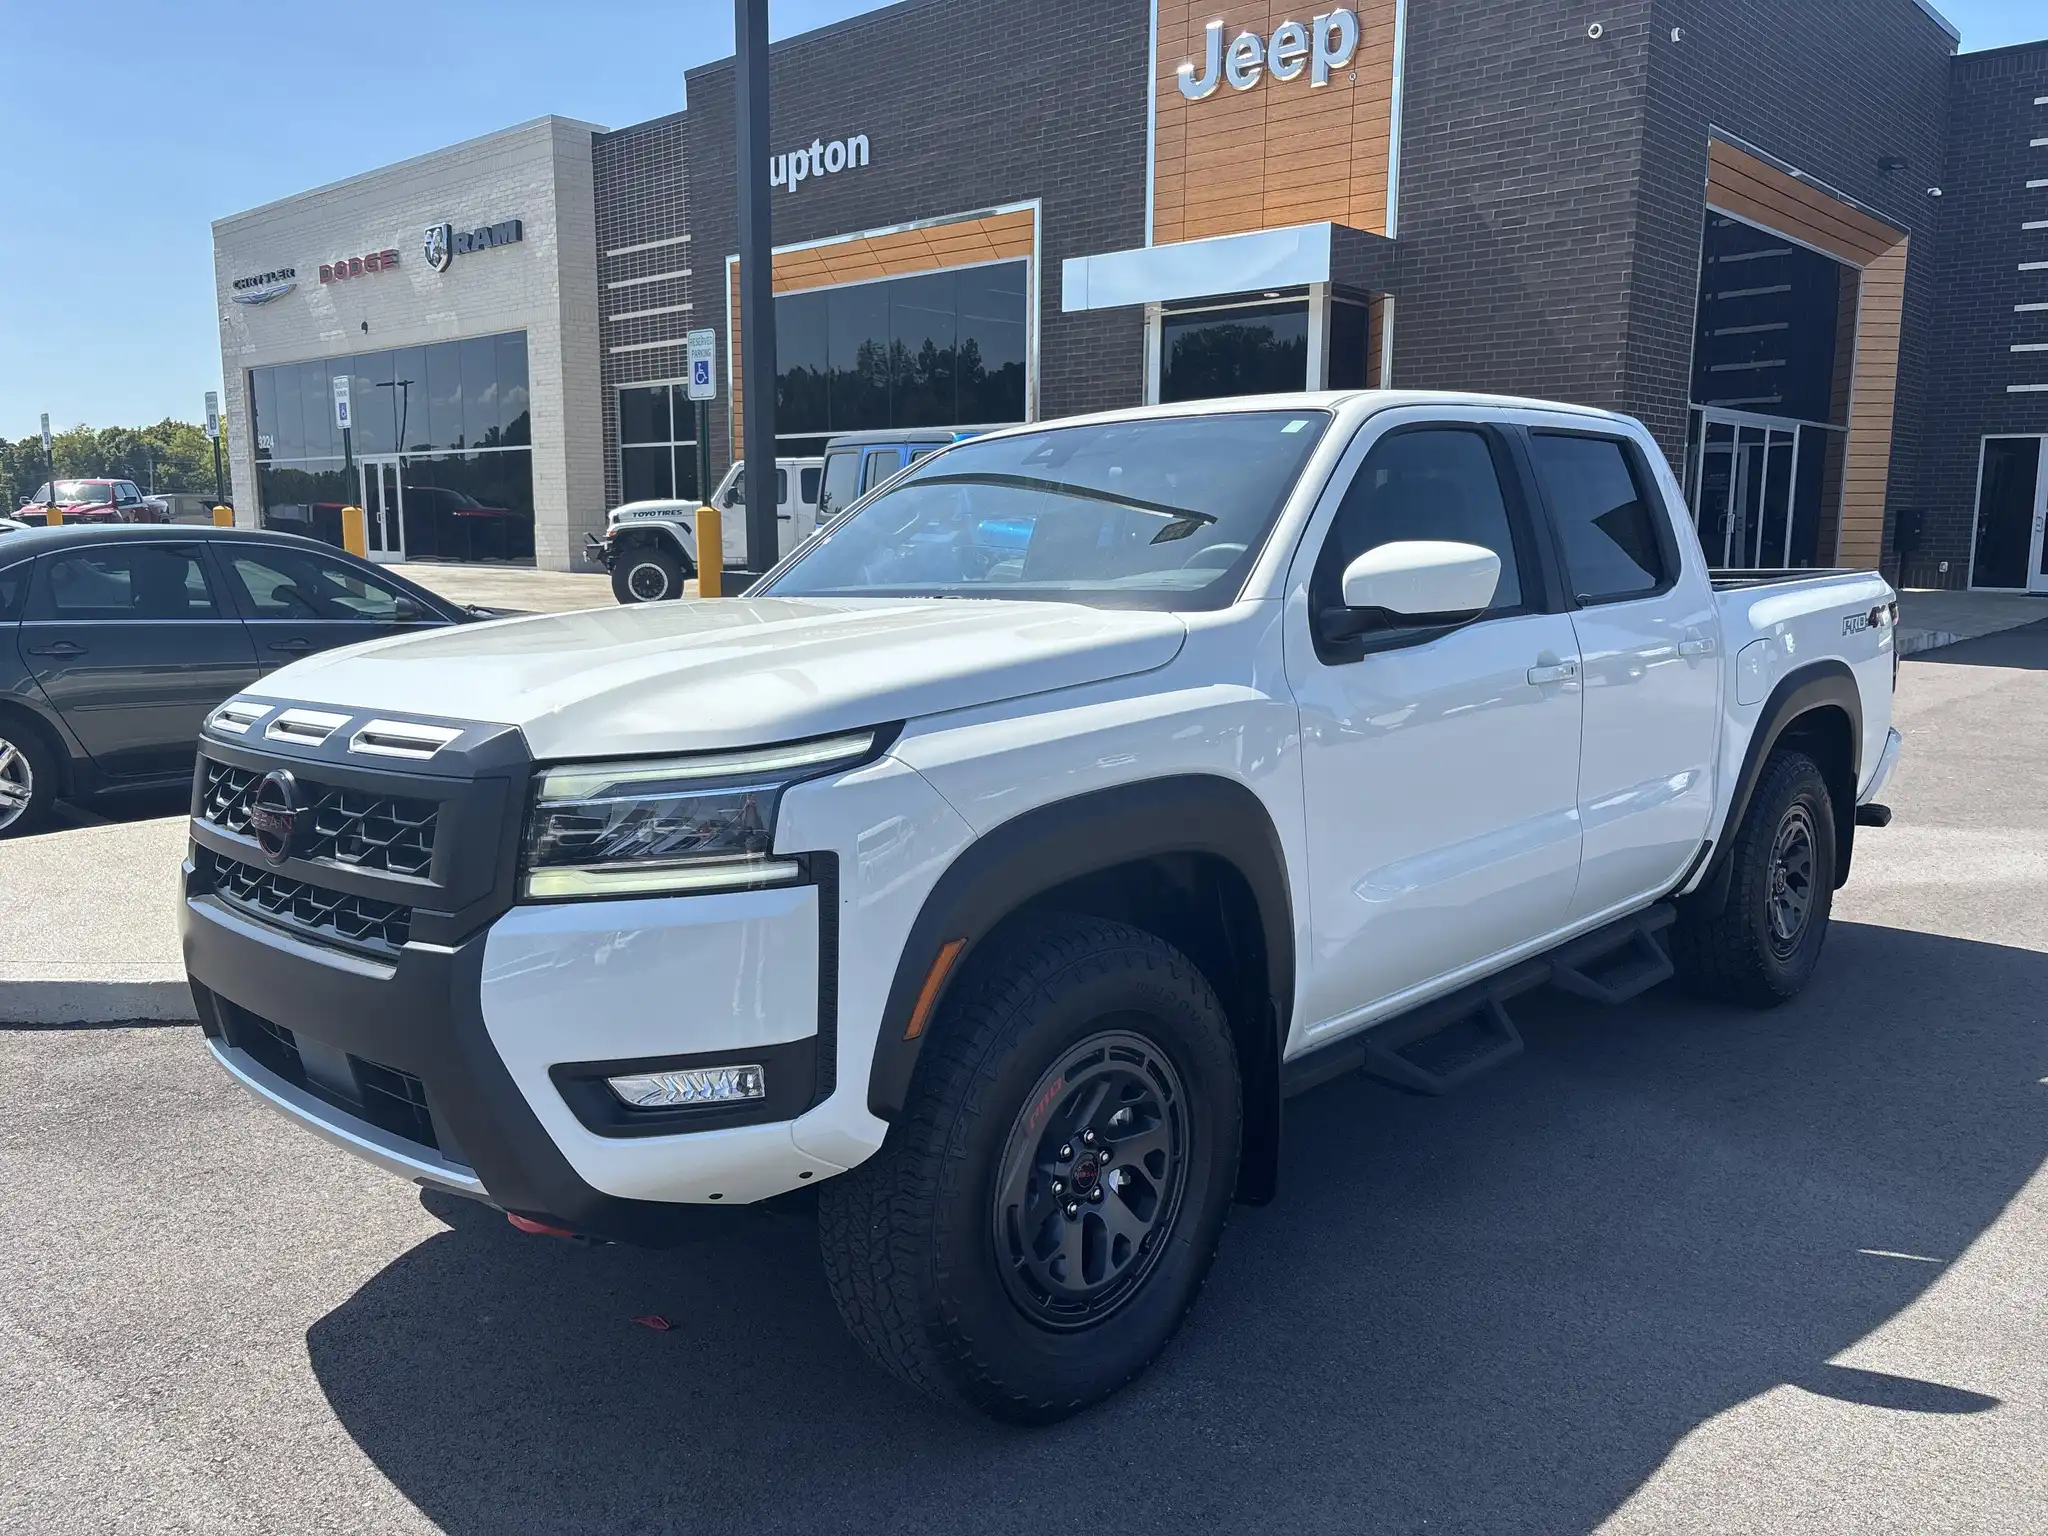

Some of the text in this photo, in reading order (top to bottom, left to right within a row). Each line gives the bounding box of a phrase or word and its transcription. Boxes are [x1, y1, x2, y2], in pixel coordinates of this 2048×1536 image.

[1176, 8, 1360, 100] Jeep
[769, 134, 869, 193] upton
[452, 219, 522, 255] RAM
[319, 249, 398, 284] DODGE
[632, 509, 683, 518] TOYO TIRES
